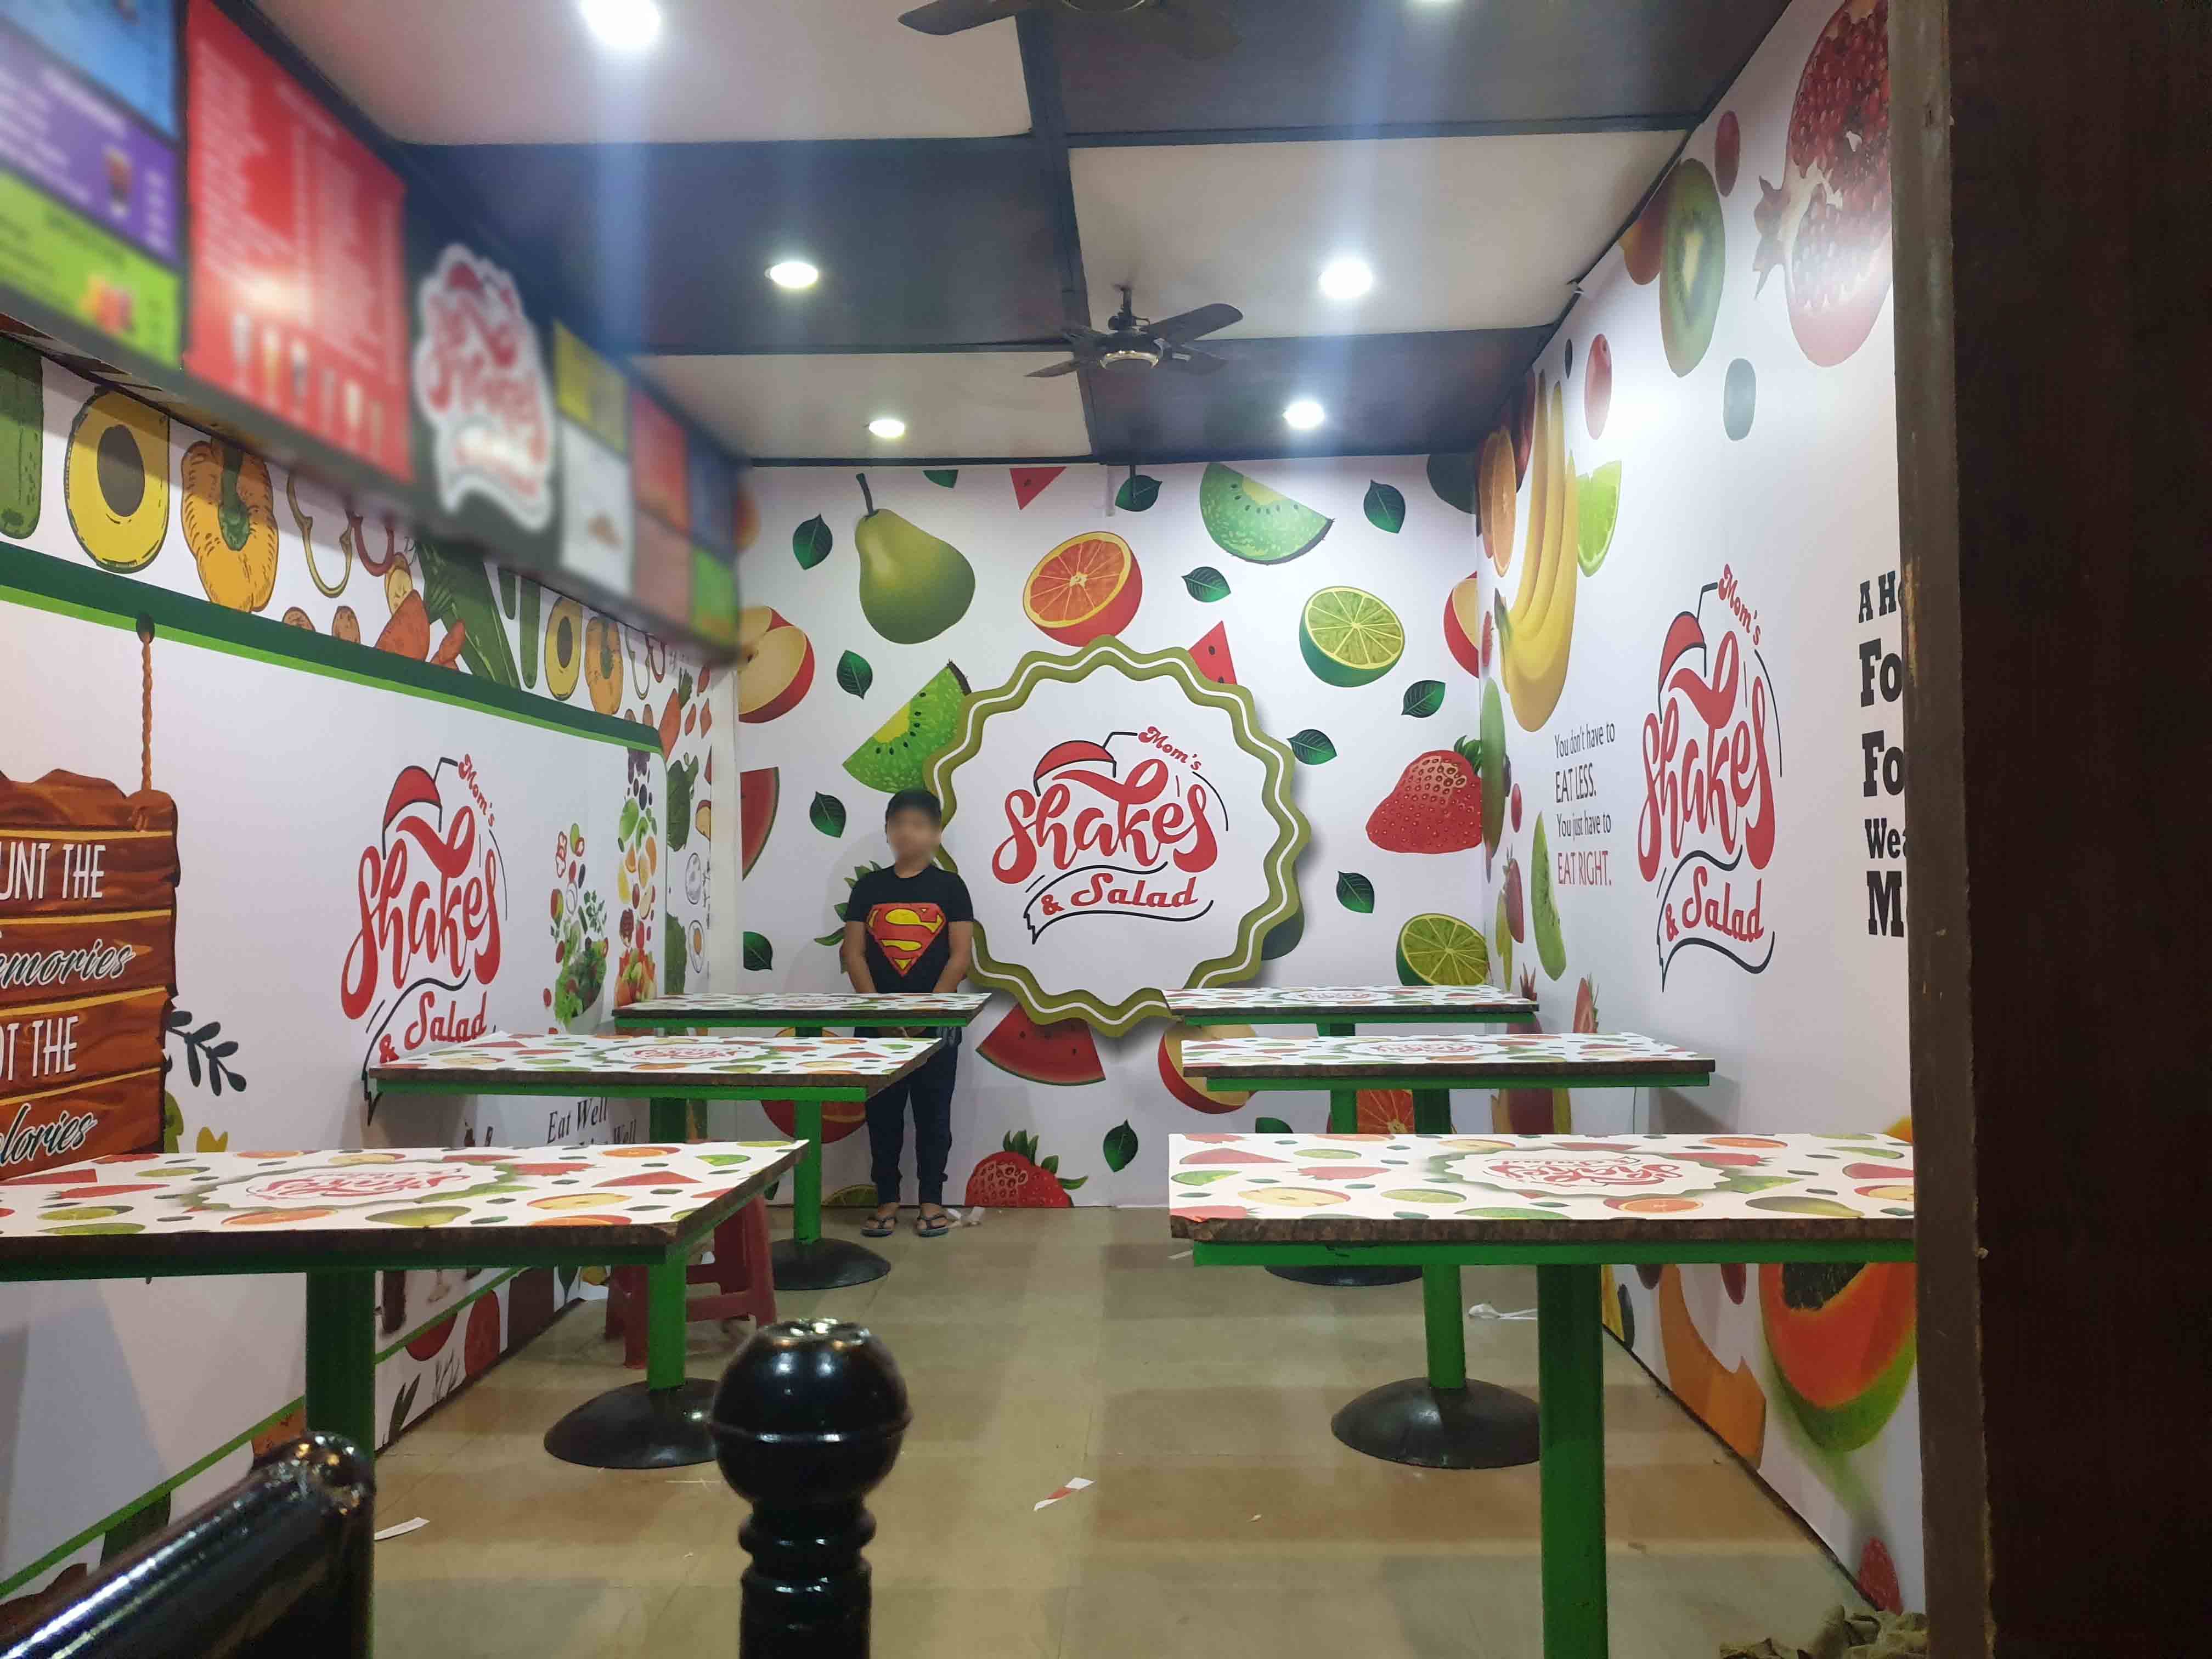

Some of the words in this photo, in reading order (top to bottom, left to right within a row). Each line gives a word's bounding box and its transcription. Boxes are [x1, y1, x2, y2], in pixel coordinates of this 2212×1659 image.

[1718, 563, 1760, 645] Mom's
[1859, 580, 1874, 623] A
[1878, 571, 1902, 616] H
[1138, 726, 1202, 771] Mom's
[1555, 733, 1569, 758] You
[1570, 726, 1585, 755] don't
[1586, 724, 1604, 749] have
[1606, 723, 1615, 743] to
[1637, 631, 1775, 882] Shakes
[459, 754, 495, 826] Mom's
[1555, 768, 1573, 803] EAT
[1576, 763, 1596, 800] LESS.
[992, 759, 1217, 884] Shakes
[1556, 813, 1571, 837] You
[1572, 813, 1583, 841] just
[1584, 810, 1600, 835] have
[1602, 812, 1611, 833] to
[1865, 817, 1906, 859] We
[62, 844, 106, 899] THE
[1041, 895, 1064, 915] &
[1070, 873, 1198, 907] Salad
[1558, 852, 1576, 885] EAT
[1578, 850, 1611, 886] RIGHT.
[341, 805, 500, 1019] Shakes
[1666, 904, 1679, 942] &
[1682, 866, 1764, 942] Salad
[32, 1015, 79, 1077] THE
[404, 991, 487, 1050] Salad
[0, 1102, 98, 1167] lories
[547, 1110, 572, 1145] Eat
[577, 1096, 607, 1131] Well
